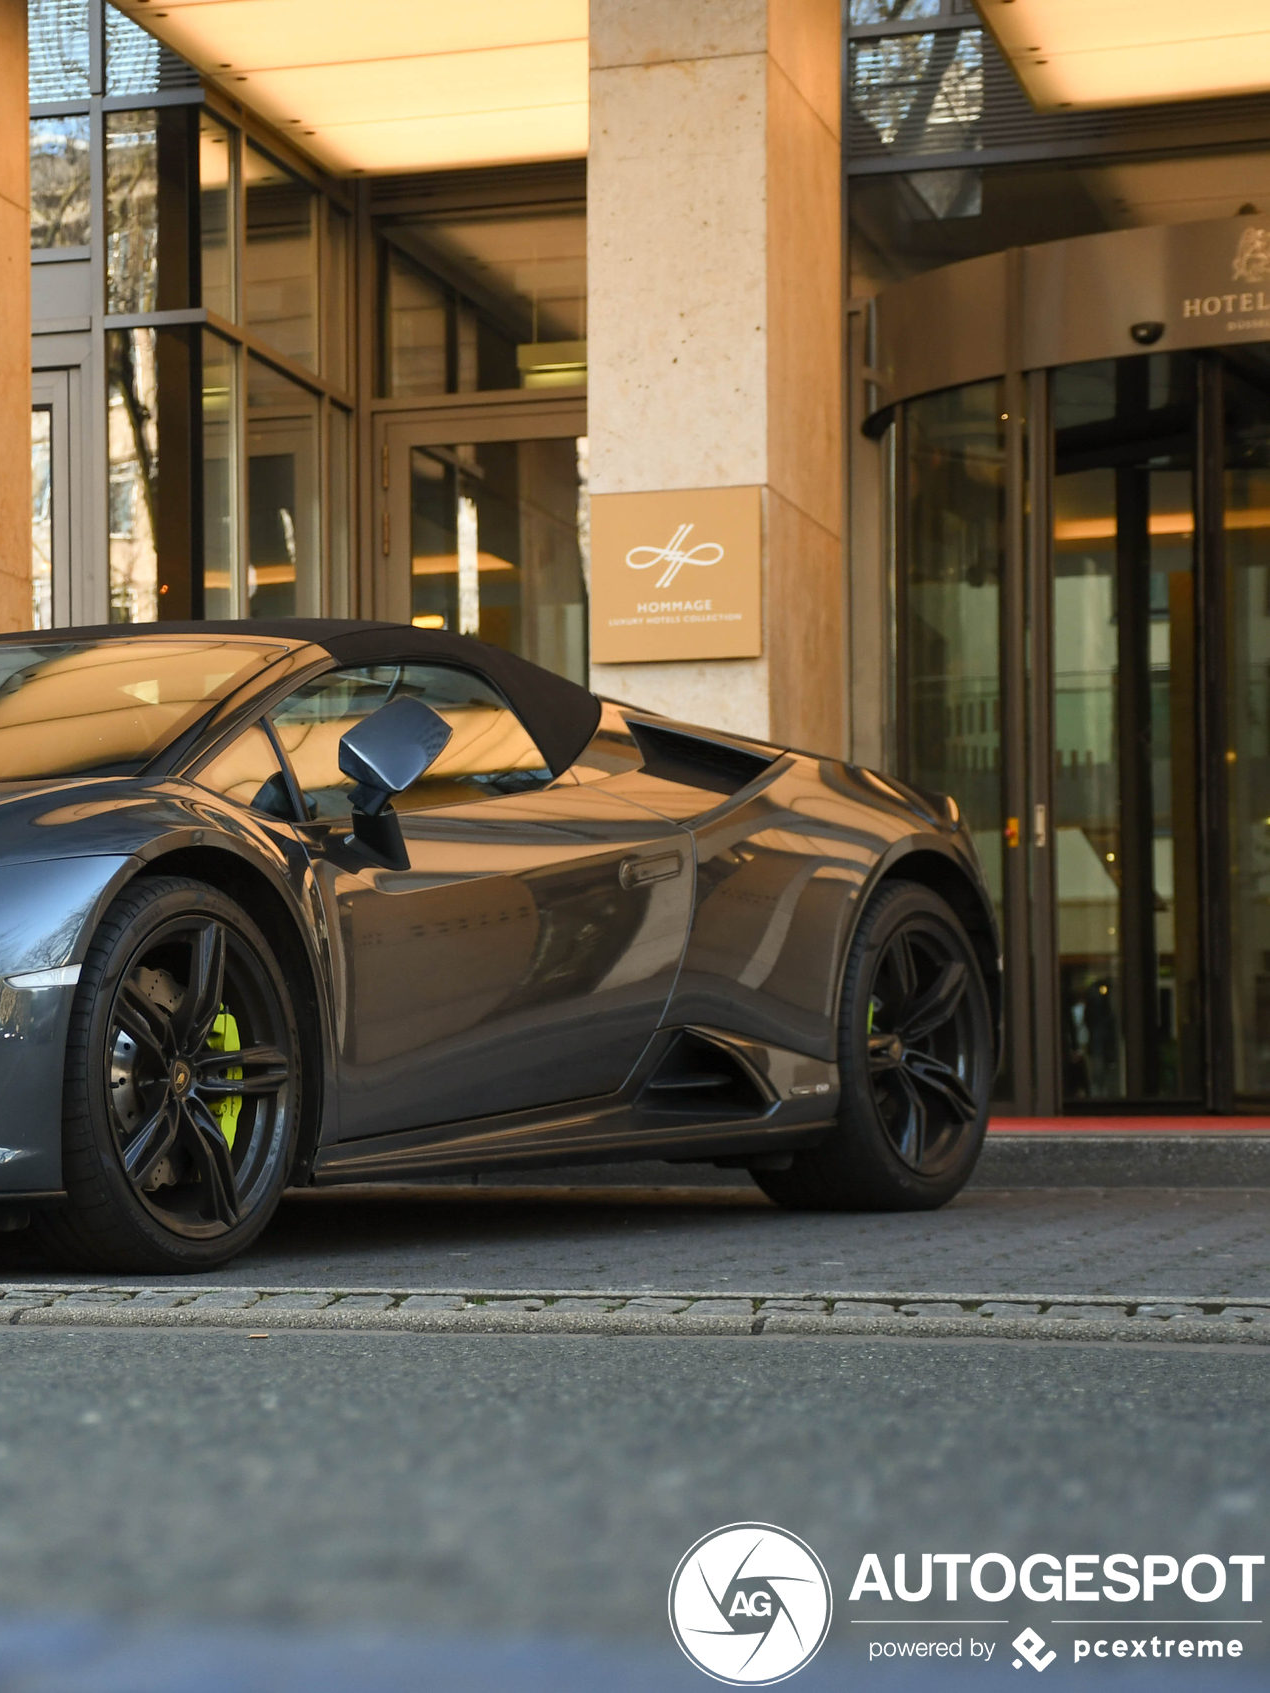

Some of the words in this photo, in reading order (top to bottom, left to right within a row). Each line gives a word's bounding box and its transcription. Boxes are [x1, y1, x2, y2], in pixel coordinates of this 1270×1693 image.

[1183, 291, 1270, 318] HOTEL
[637, 599, 712, 613] HOMMAGE
[608, 617, 643, 627] LUXURY
[646, 615, 681, 625] HOTELS
[683, 613, 742, 623] COLLECTION
